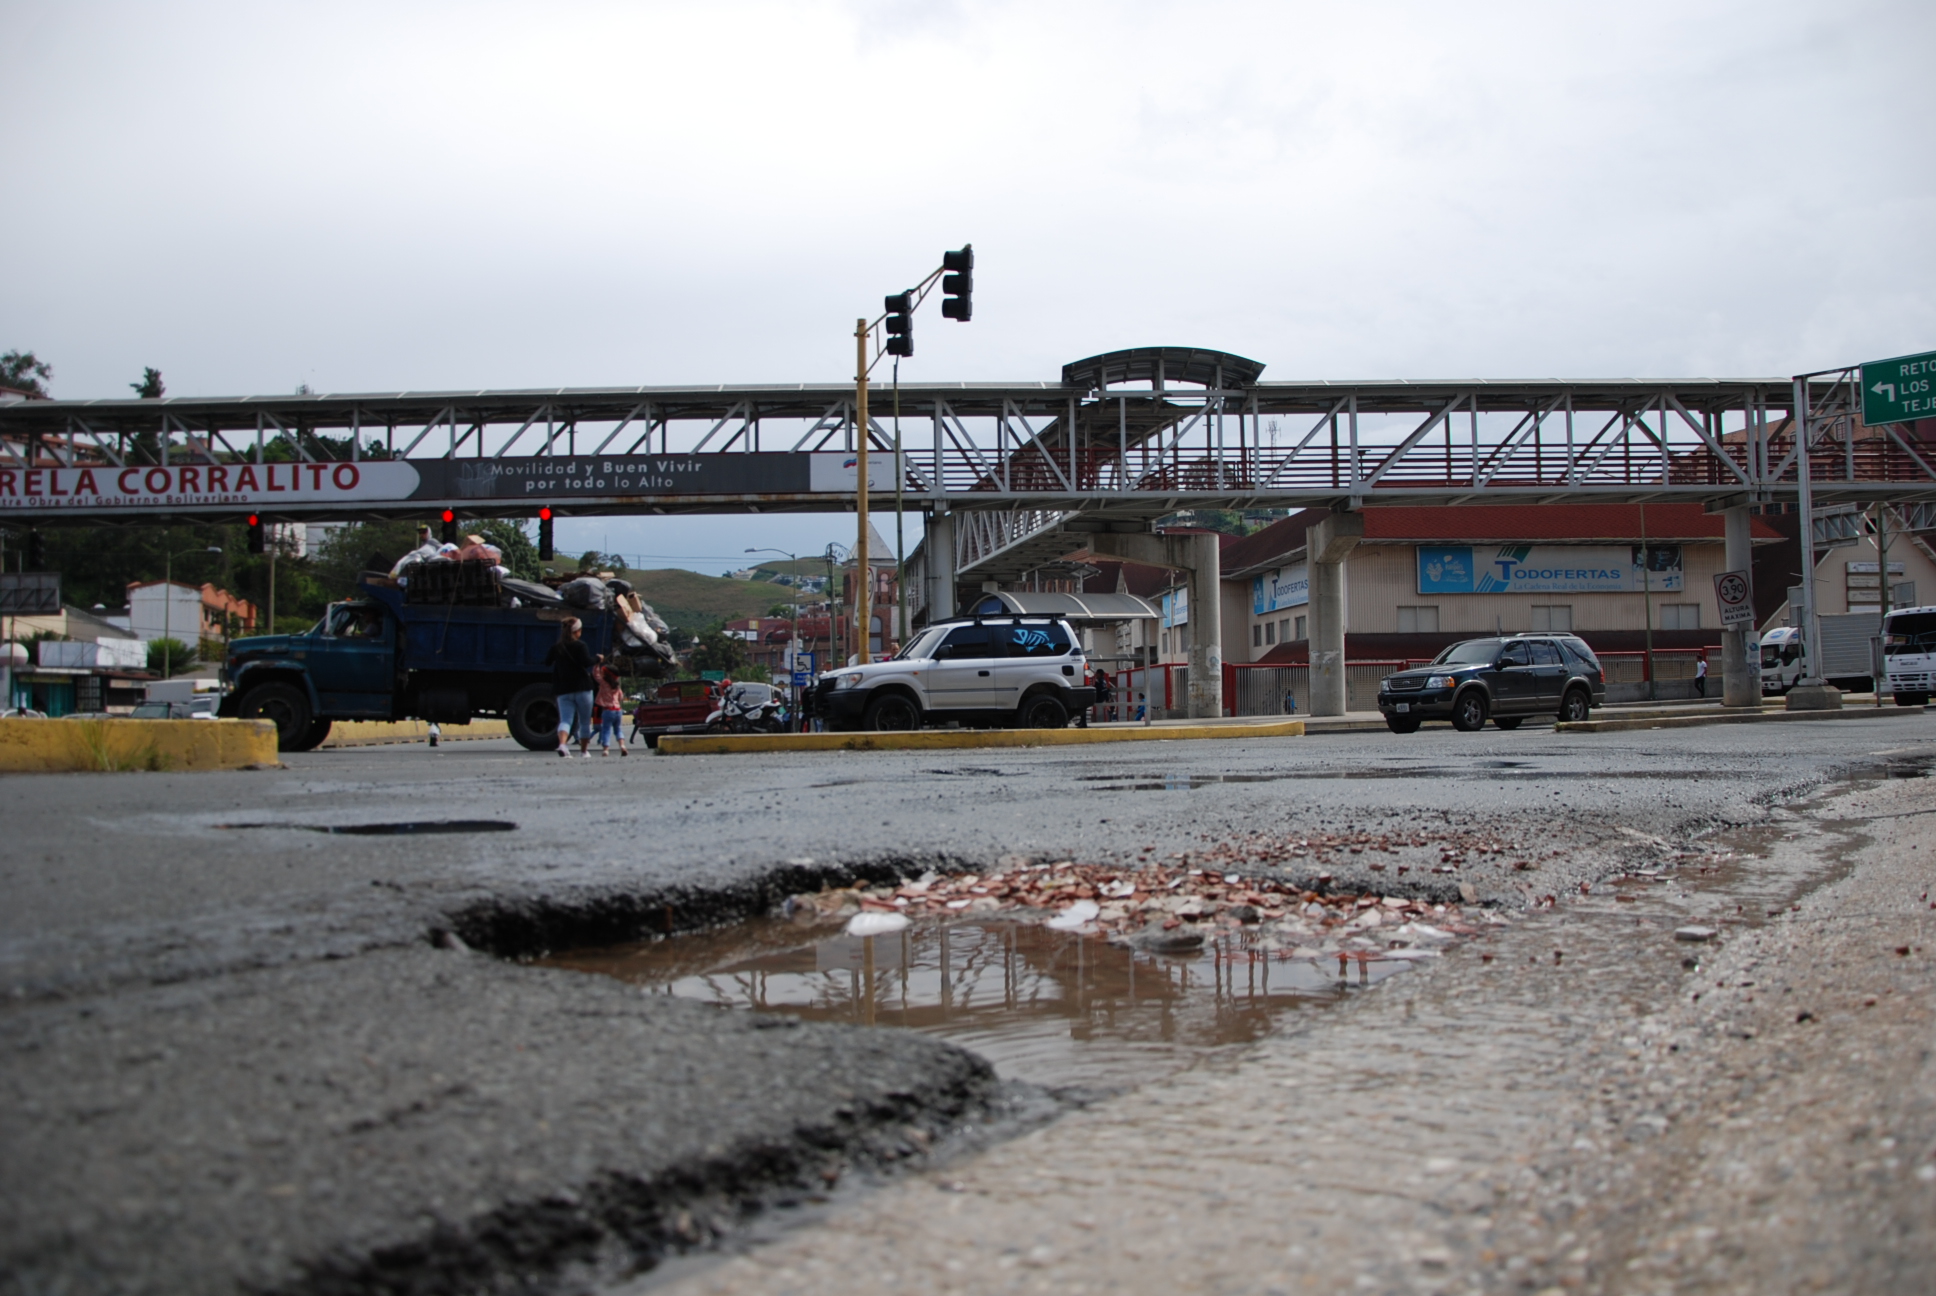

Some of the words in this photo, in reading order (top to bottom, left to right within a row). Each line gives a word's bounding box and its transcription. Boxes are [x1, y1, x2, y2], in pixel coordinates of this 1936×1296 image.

[1900, 360, 1936, 376] RETO
[1900, 379, 1929, 395] LOS
[490, 461, 576, 475] Movilidad
[585, 464, 594, 477] y
[603, 461, 648, 473] Buen
[656, 460, 702, 473] Vivir
[0, 468, 100, 497] RELA
[117, 463, 361, 495] CORRALITO
[526, 480, 556, 493] por
[564, 476, 606, 489] todo
[614, 475, 630, 488] lo
[638, 475, 674, 488] Alto
[28, 496, 61, 506] Obra
[67, 496, 89, 506] del
[95, 494, 160, 506] Gobierno
[166, 493, 249, 505] Bolivariano
[1495, 561, 1620, 580] TODOFERTAS
[1272, 579, 1308, 598] TODOFERTAS
[1513, 582, 1523, 590] La
[1524, 582, 1551, 590] Cadena
[1552, 582, 1568, 590] Real
[1569, 582, 1578, 590] de
[1722, 584, 1744, 596] 3.90
[1724, 605, 1750, 614] ALTURA
[1725, 612, 1751, 620] MAXIMA
